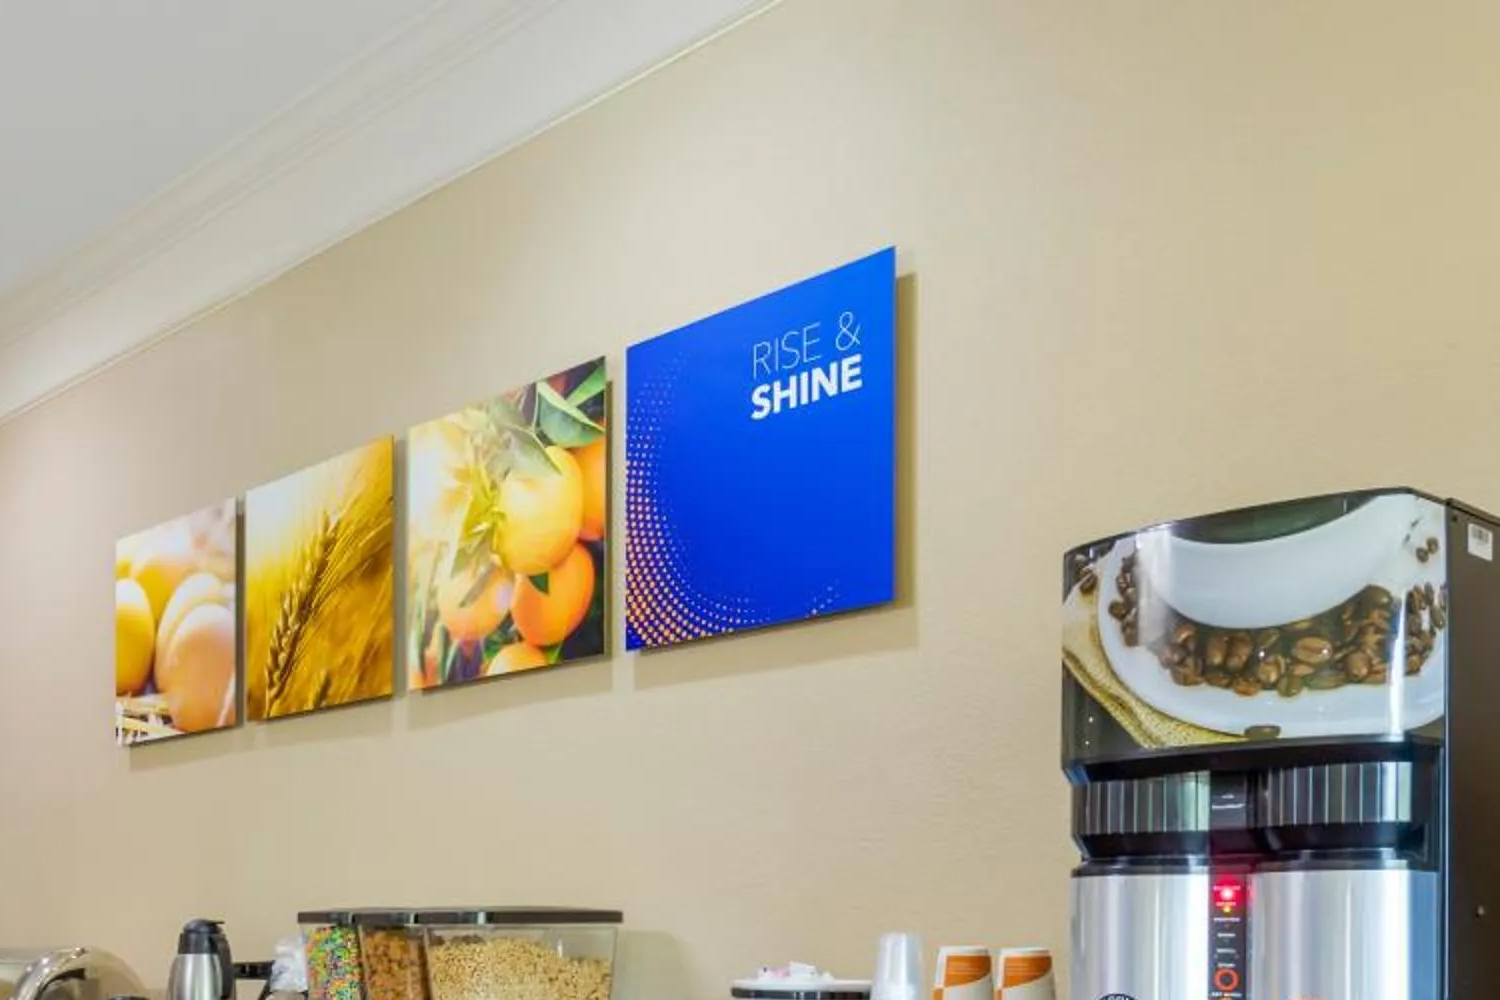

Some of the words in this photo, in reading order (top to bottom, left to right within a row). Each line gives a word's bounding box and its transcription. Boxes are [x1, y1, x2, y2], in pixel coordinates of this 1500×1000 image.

[752, 321, 822, 380] RISE
[835, 310, 861, 352] &
[750, 352, 863, 421] SHINE
